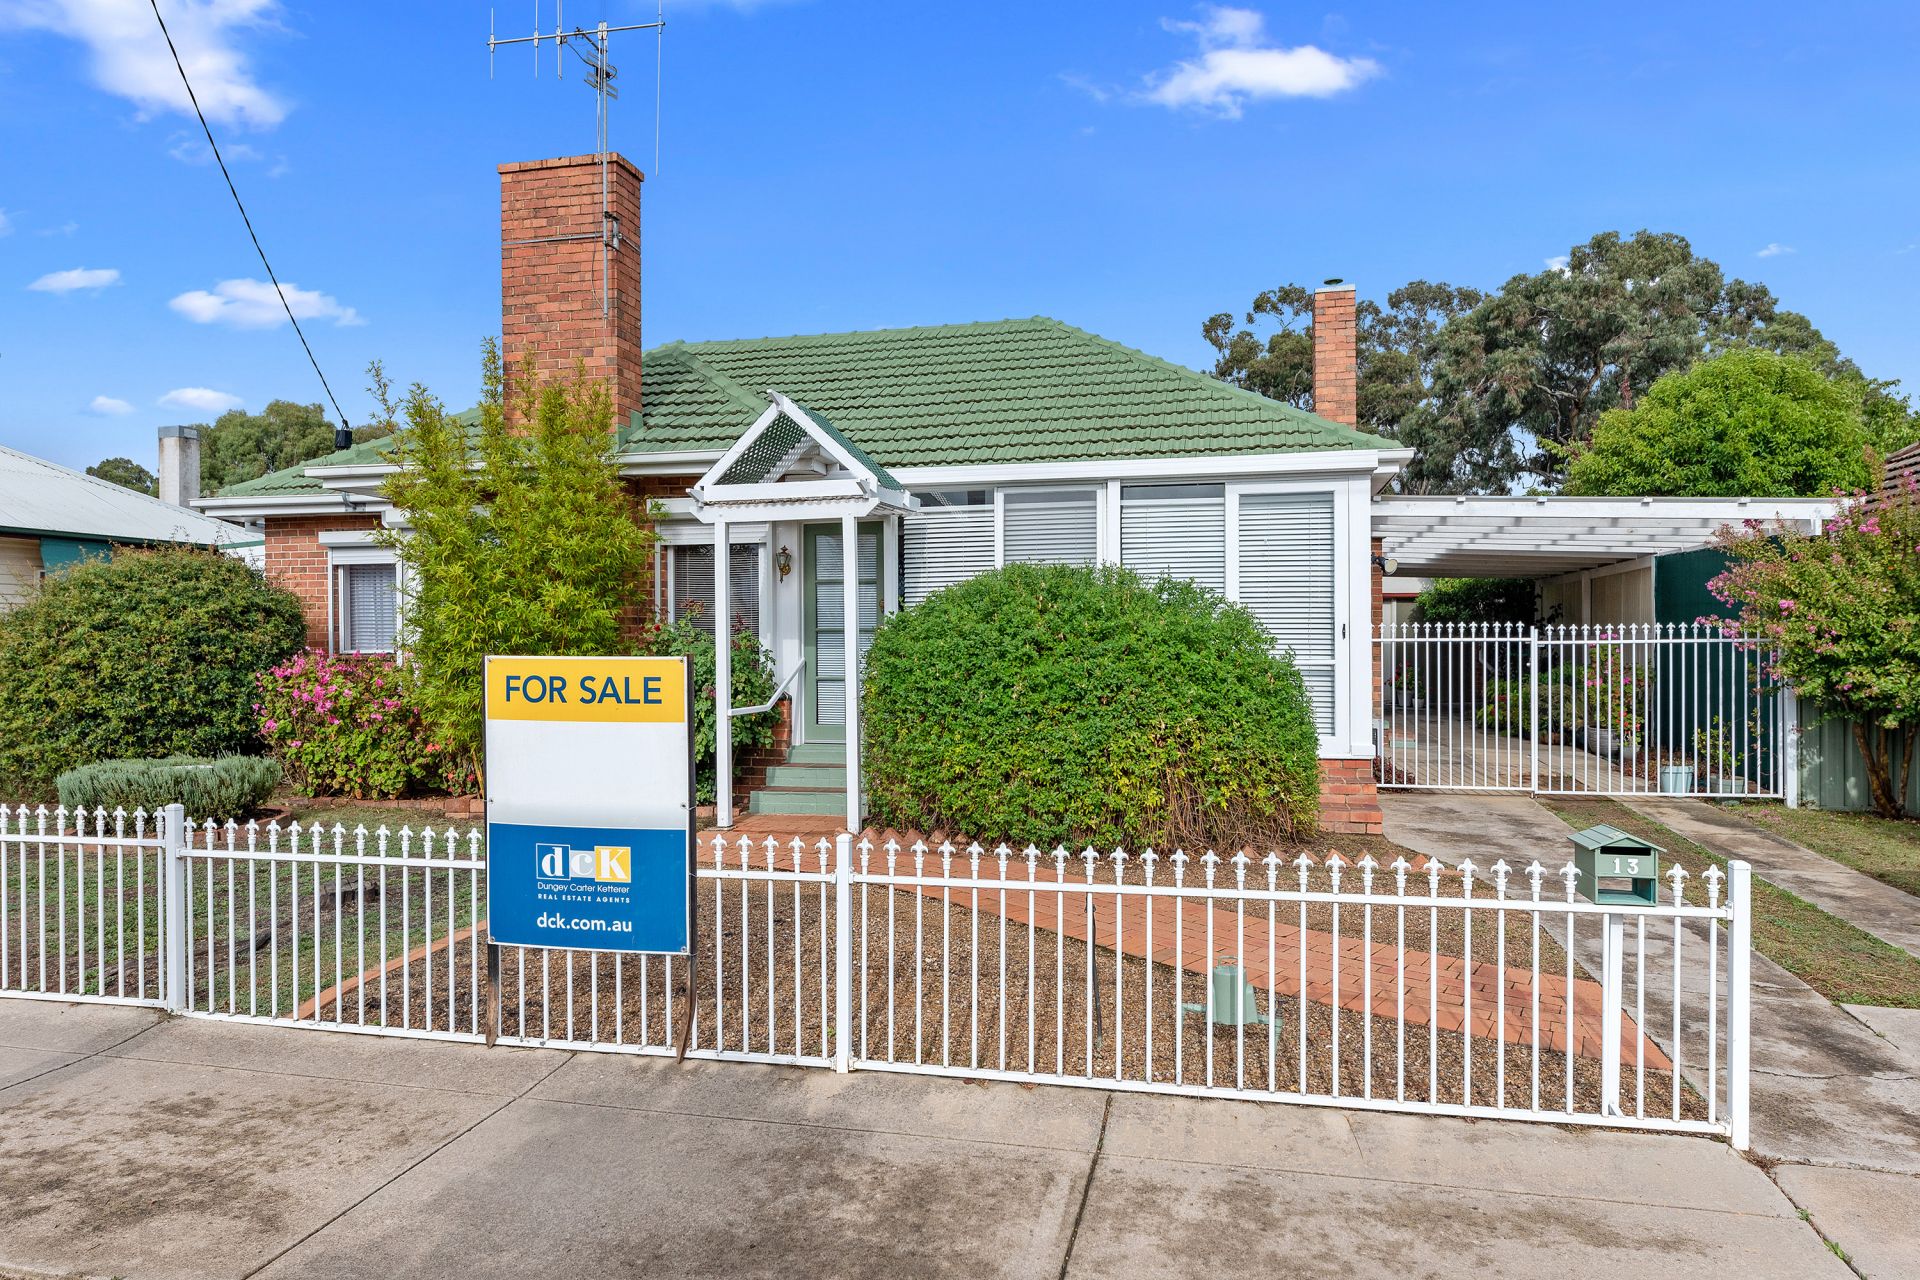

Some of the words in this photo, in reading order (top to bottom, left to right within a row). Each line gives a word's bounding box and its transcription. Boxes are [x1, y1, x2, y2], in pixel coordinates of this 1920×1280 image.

[505, 675, 567, 703] FOR
[579, 675, 662, 704] SALE
[1613, 857, 1639, 875] 13
[537, 881, 568, 892] Dungey
[569, 883, 596, 892] Carter
[597, 884, 630, 893] Ketterer
[562, 894, 592, 902] ESTATE
[596, 895, 630, 903] AGENTS
[536, 912, 632, 932] dck.com.au
